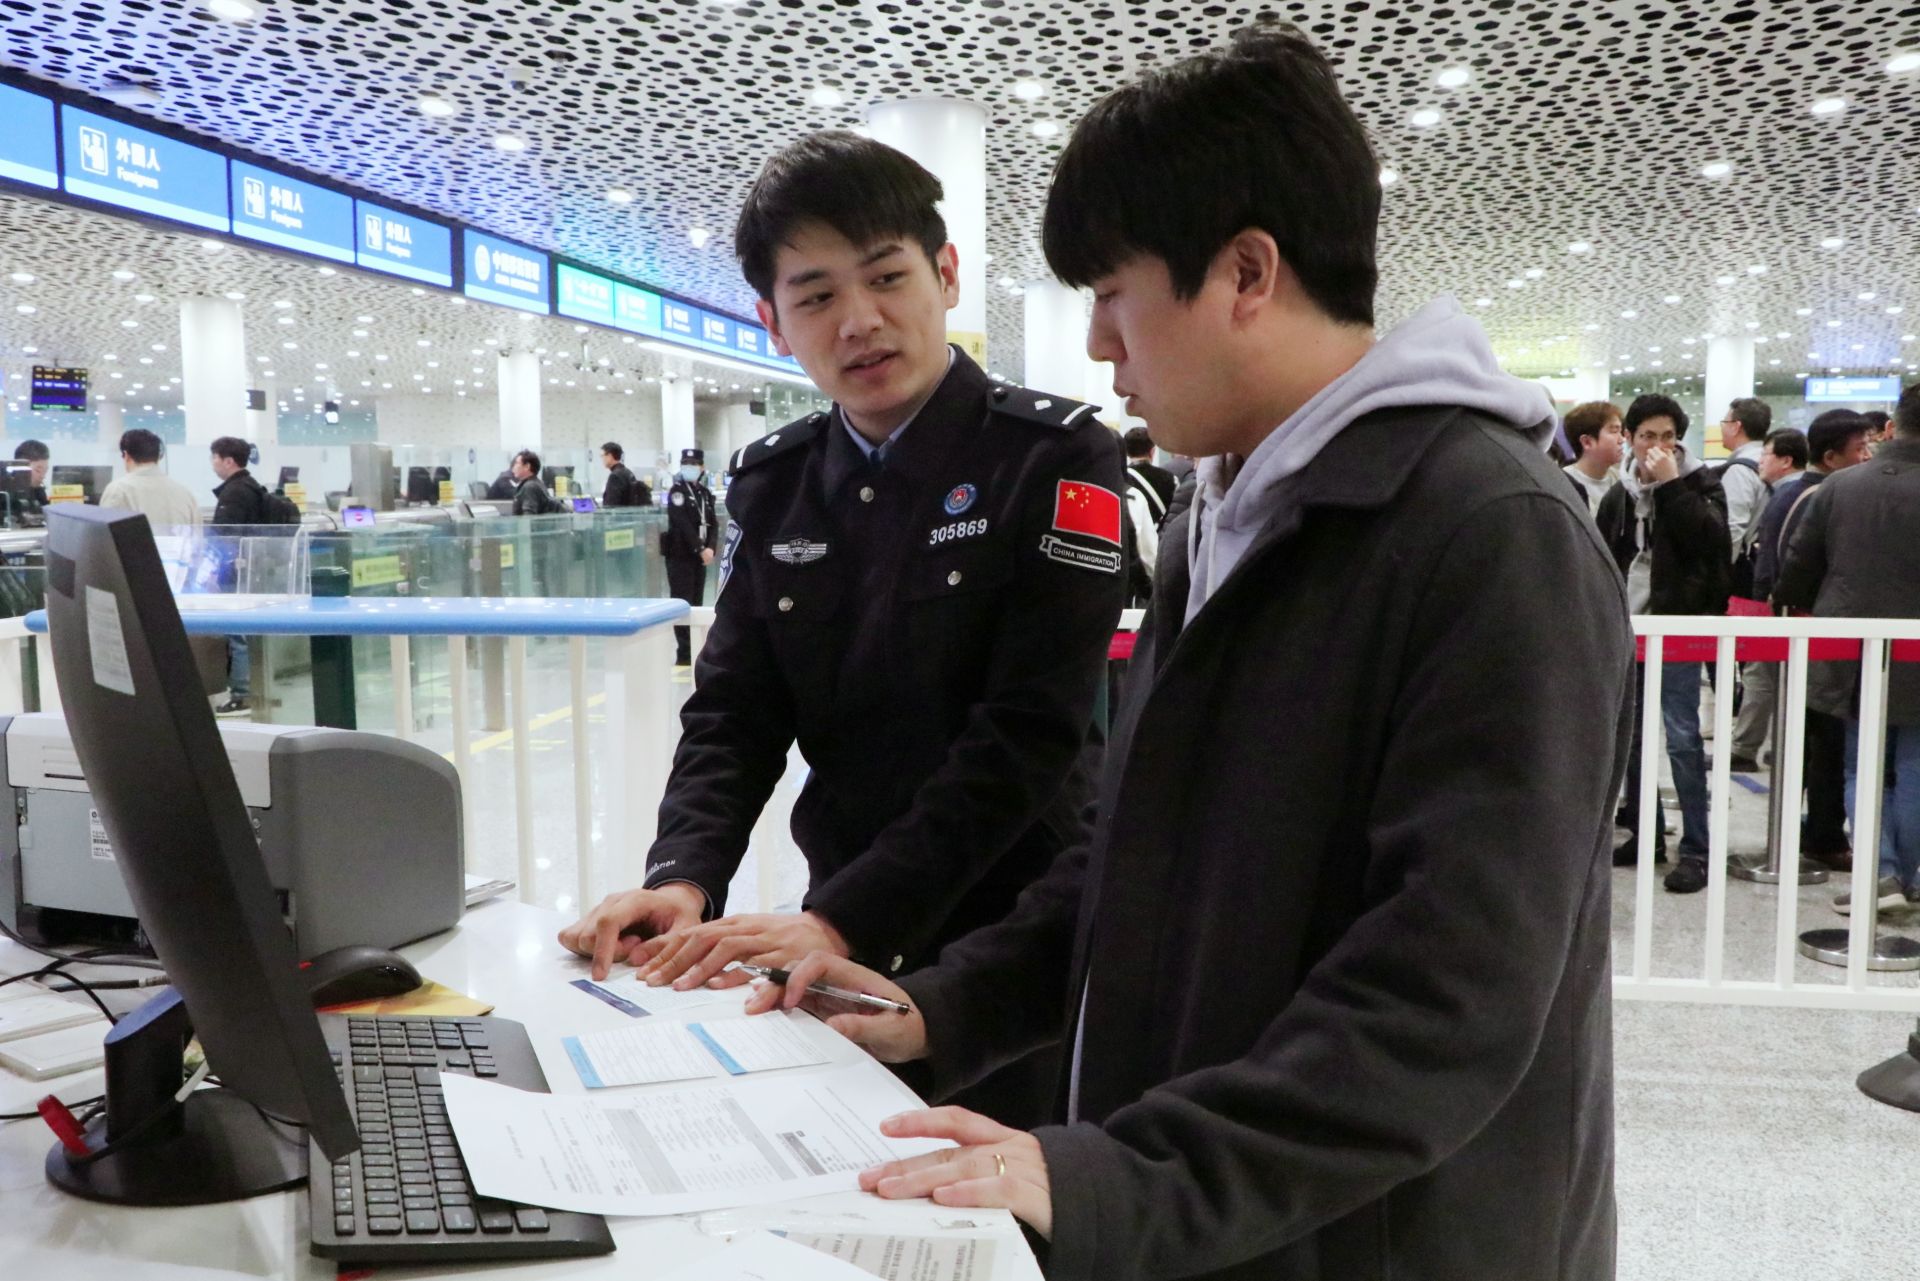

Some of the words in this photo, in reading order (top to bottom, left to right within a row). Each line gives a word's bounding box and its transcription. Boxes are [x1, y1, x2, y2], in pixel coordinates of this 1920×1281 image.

[929, 518, 988, 545] 305869
[1053, 547, 1075, 558] CHINA
[1076, 553, 1114, 567] IMMIGRATION
